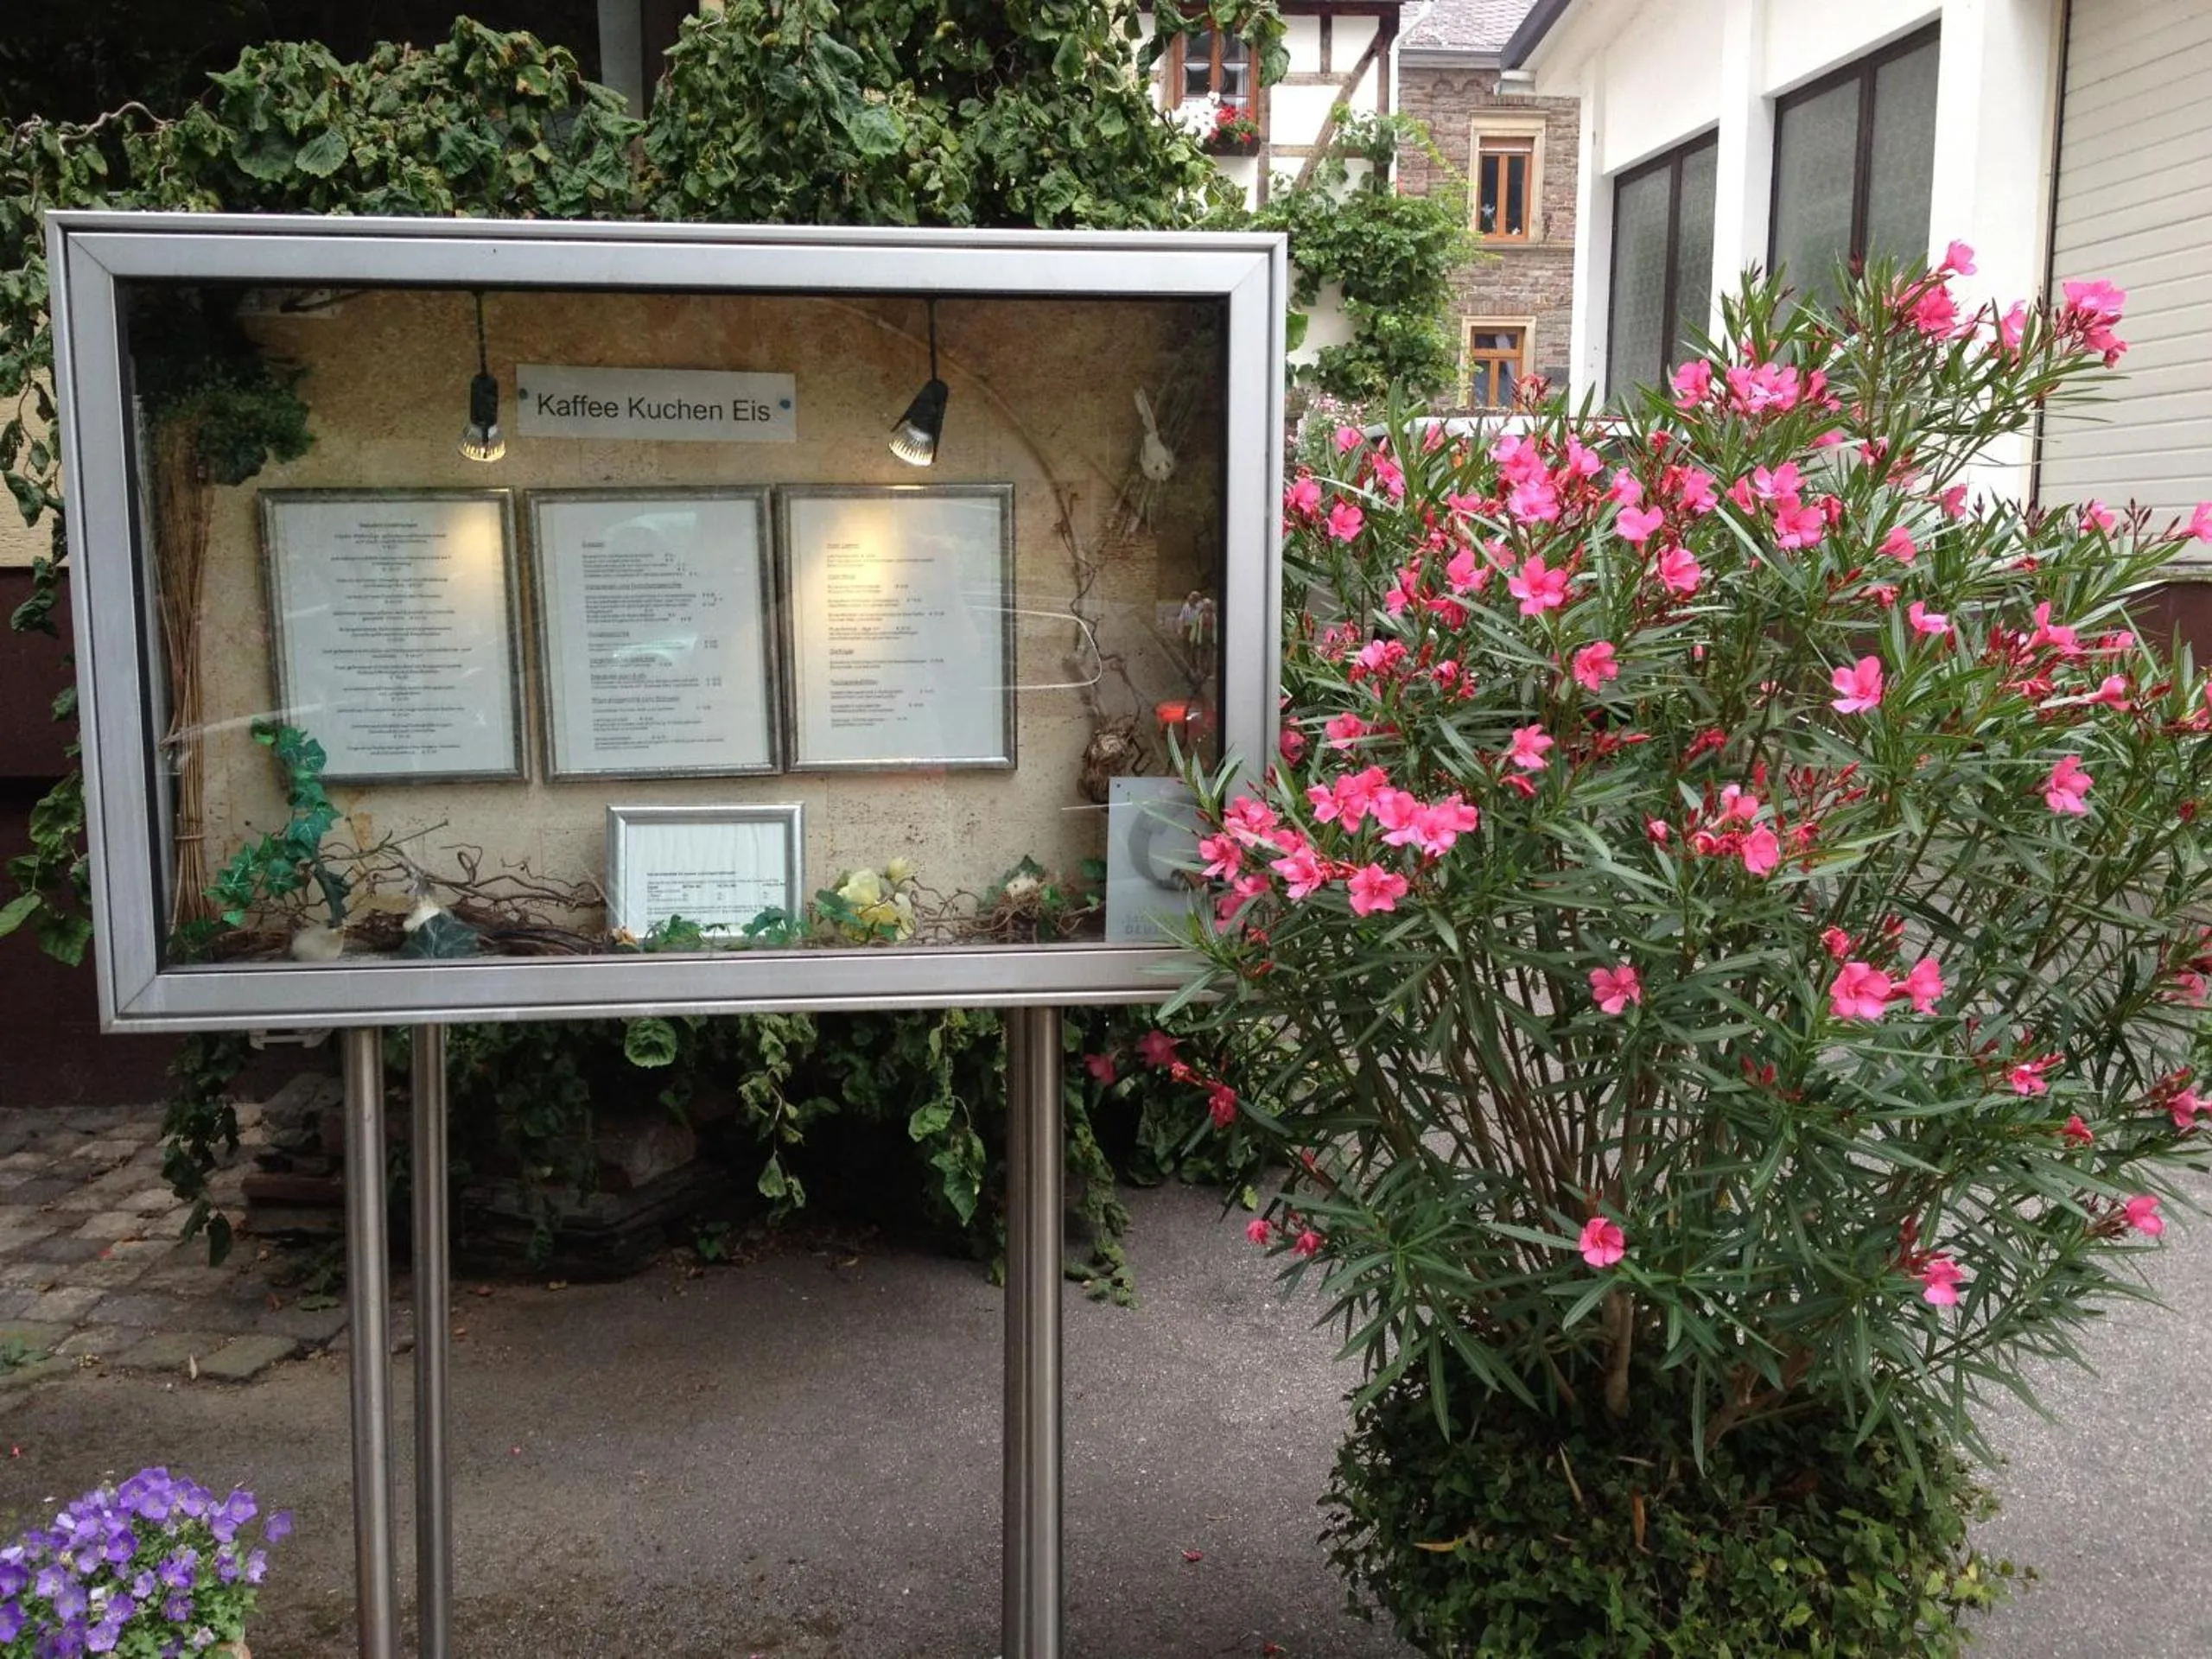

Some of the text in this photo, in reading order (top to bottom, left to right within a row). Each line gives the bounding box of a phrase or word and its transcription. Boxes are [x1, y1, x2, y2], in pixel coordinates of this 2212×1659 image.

[537, 393, 772, 423] Kaffee Kuchen Eis
